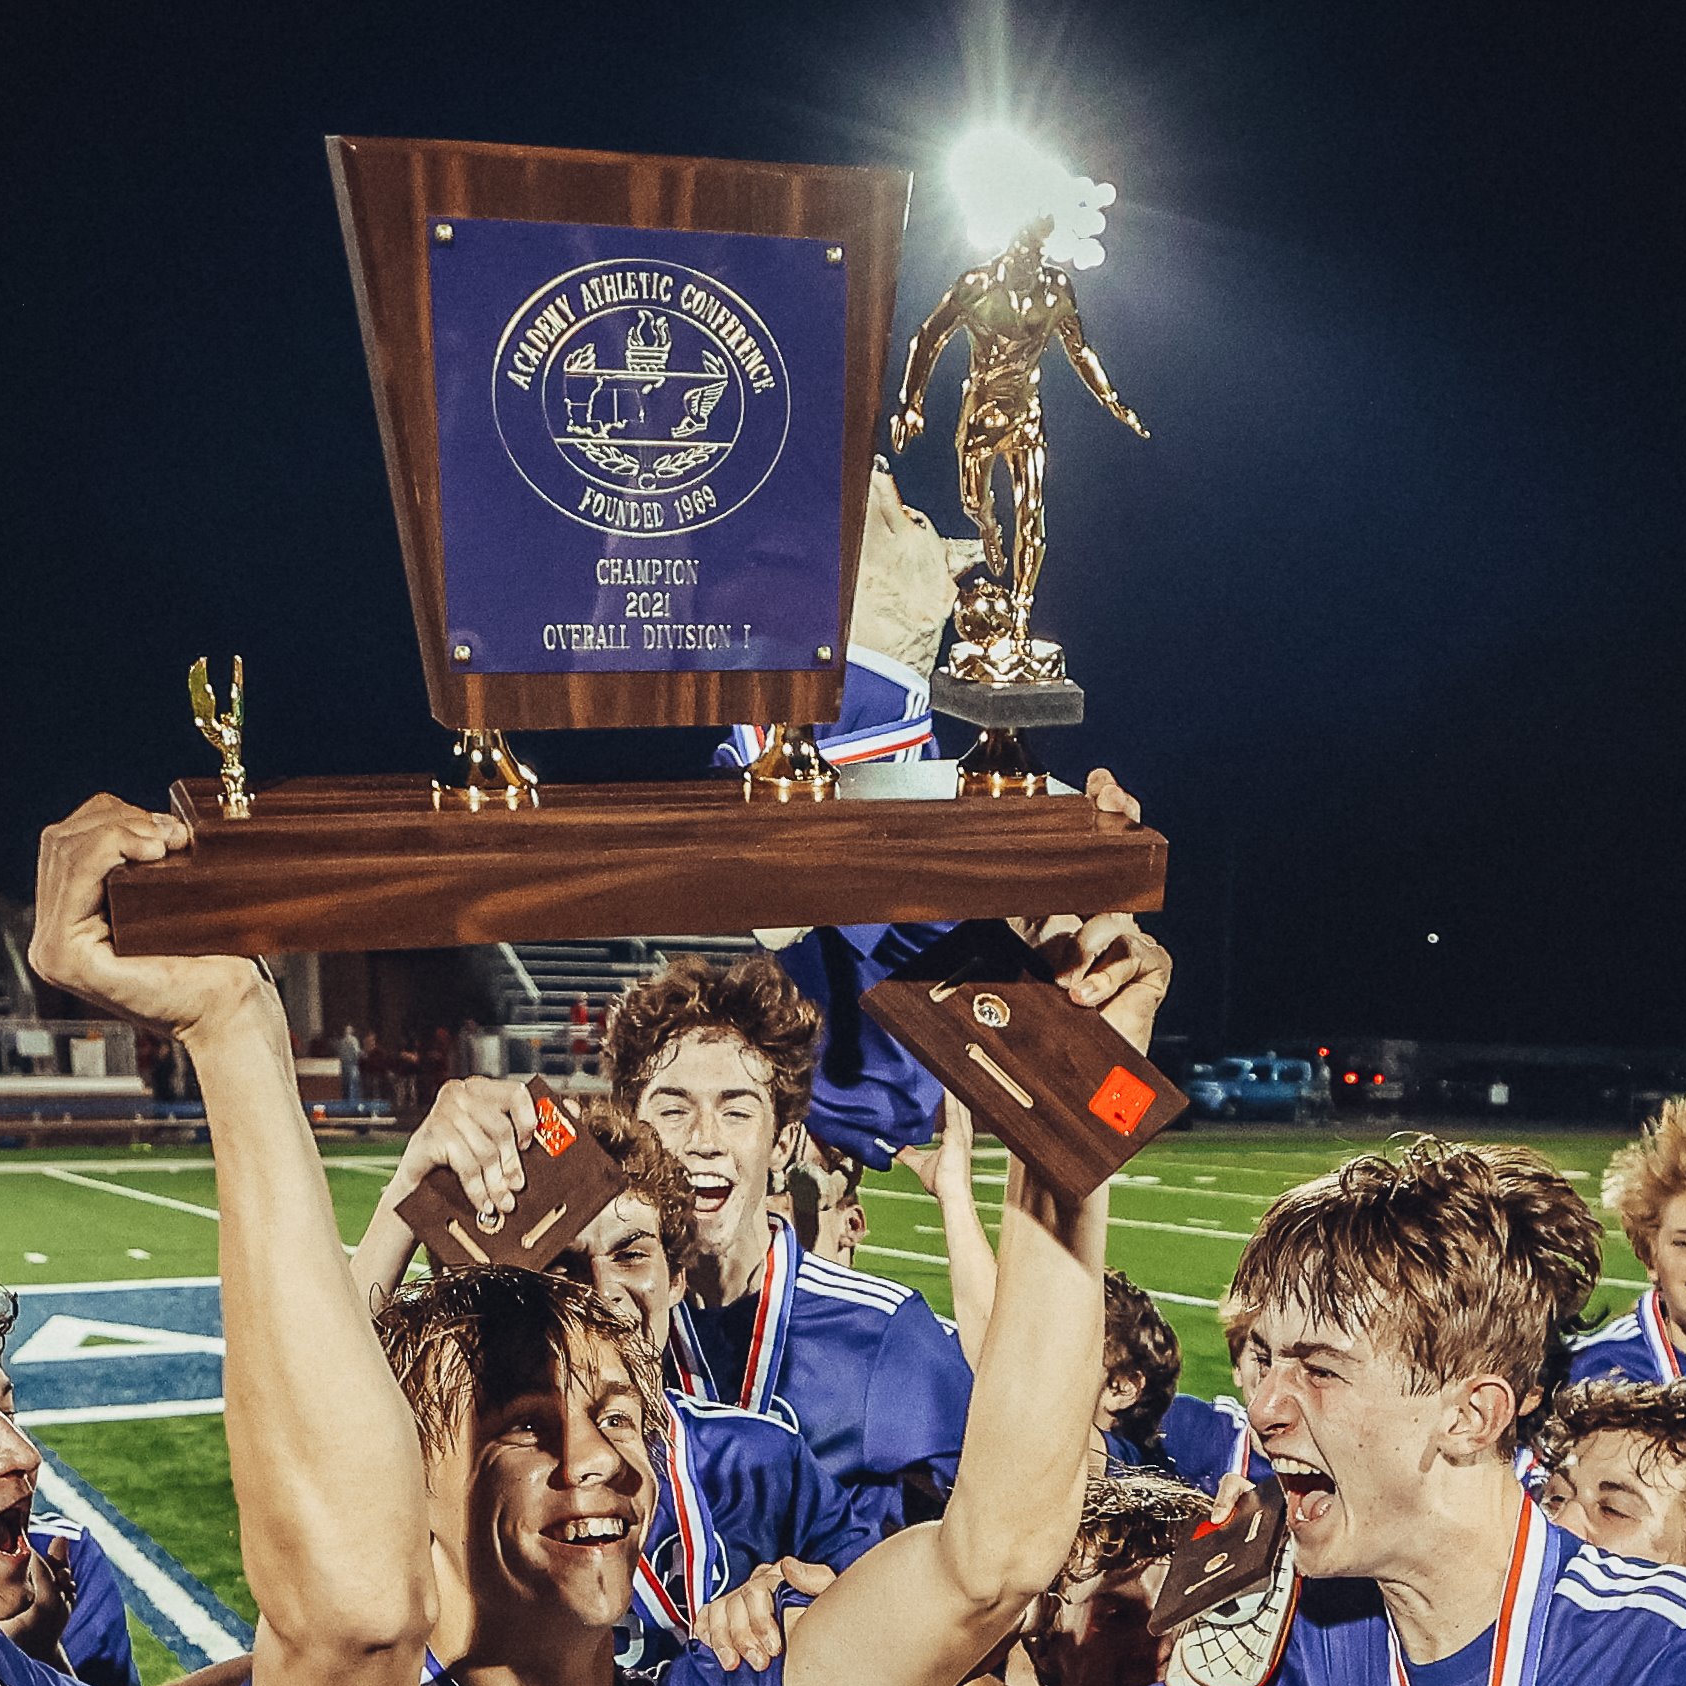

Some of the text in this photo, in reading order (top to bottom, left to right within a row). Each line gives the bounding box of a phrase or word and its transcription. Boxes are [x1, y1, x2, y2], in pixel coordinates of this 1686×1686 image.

[506, 271, 776, 394] ACADEMY ATHLETIC CONFERENCE
[578, 484, 718, 529] FOUNDED 1969
[596, 558, 700, 585] CHAMPION
[625, 591, 671, 618] 2021
[543, 624, 752, 650] OVERALL DIVISION I
